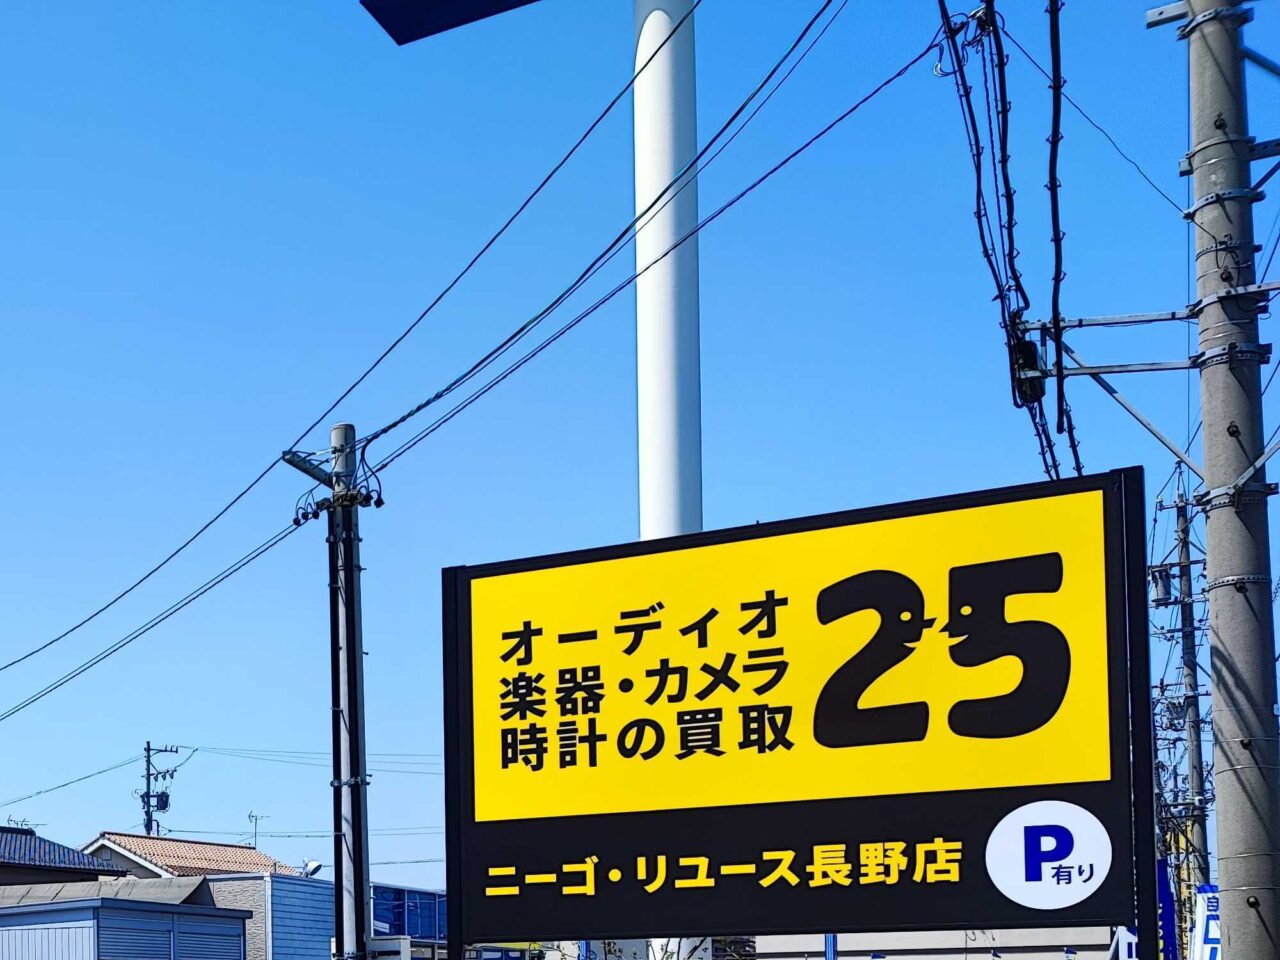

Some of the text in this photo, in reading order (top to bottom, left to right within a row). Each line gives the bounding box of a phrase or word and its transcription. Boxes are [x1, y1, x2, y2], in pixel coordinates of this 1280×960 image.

[500, 590, 789, 666] オーディオ
[813, 552, 1071, 749] 25
[499, 647, 789, 721] 楽器・カメラ
[500, 704, 793, 771] 時計の買取
[485, 837, 963, 896] ニーゴ・リユース長野店
